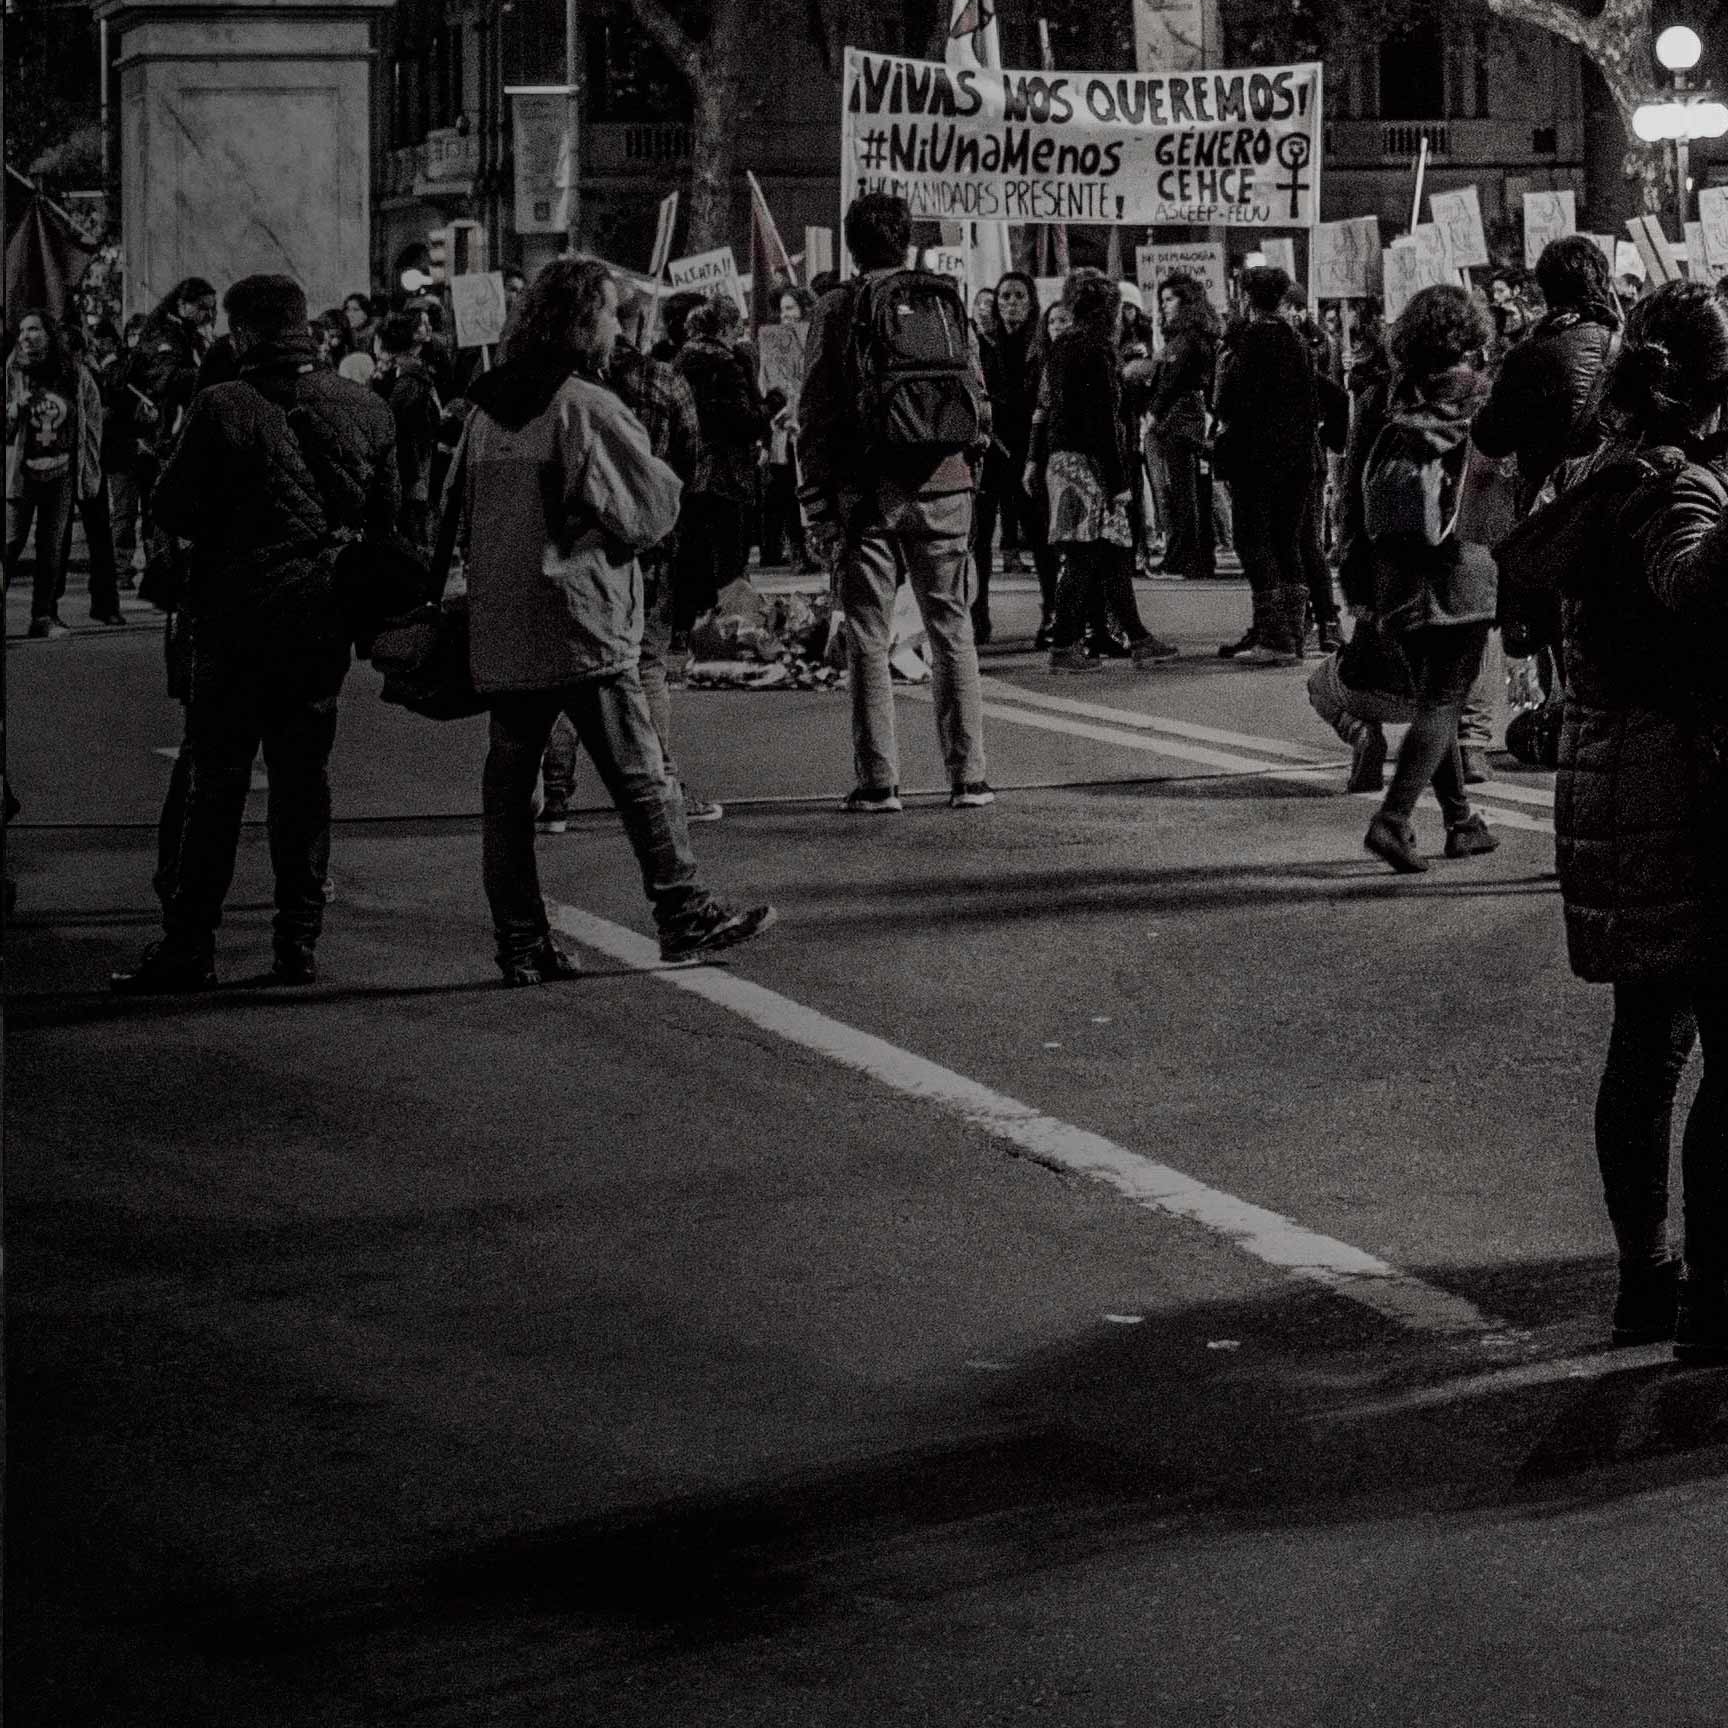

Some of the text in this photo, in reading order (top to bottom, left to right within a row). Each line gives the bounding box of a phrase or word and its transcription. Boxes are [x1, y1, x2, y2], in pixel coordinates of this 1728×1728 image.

[1003, 74, 1073, 124] NOS
[1086, 72, 1309, 124] QUEREMOS!
[1155, 126, 1271, 168] GÉNERO
[1157, 168, 1255, 204] CEHCE
